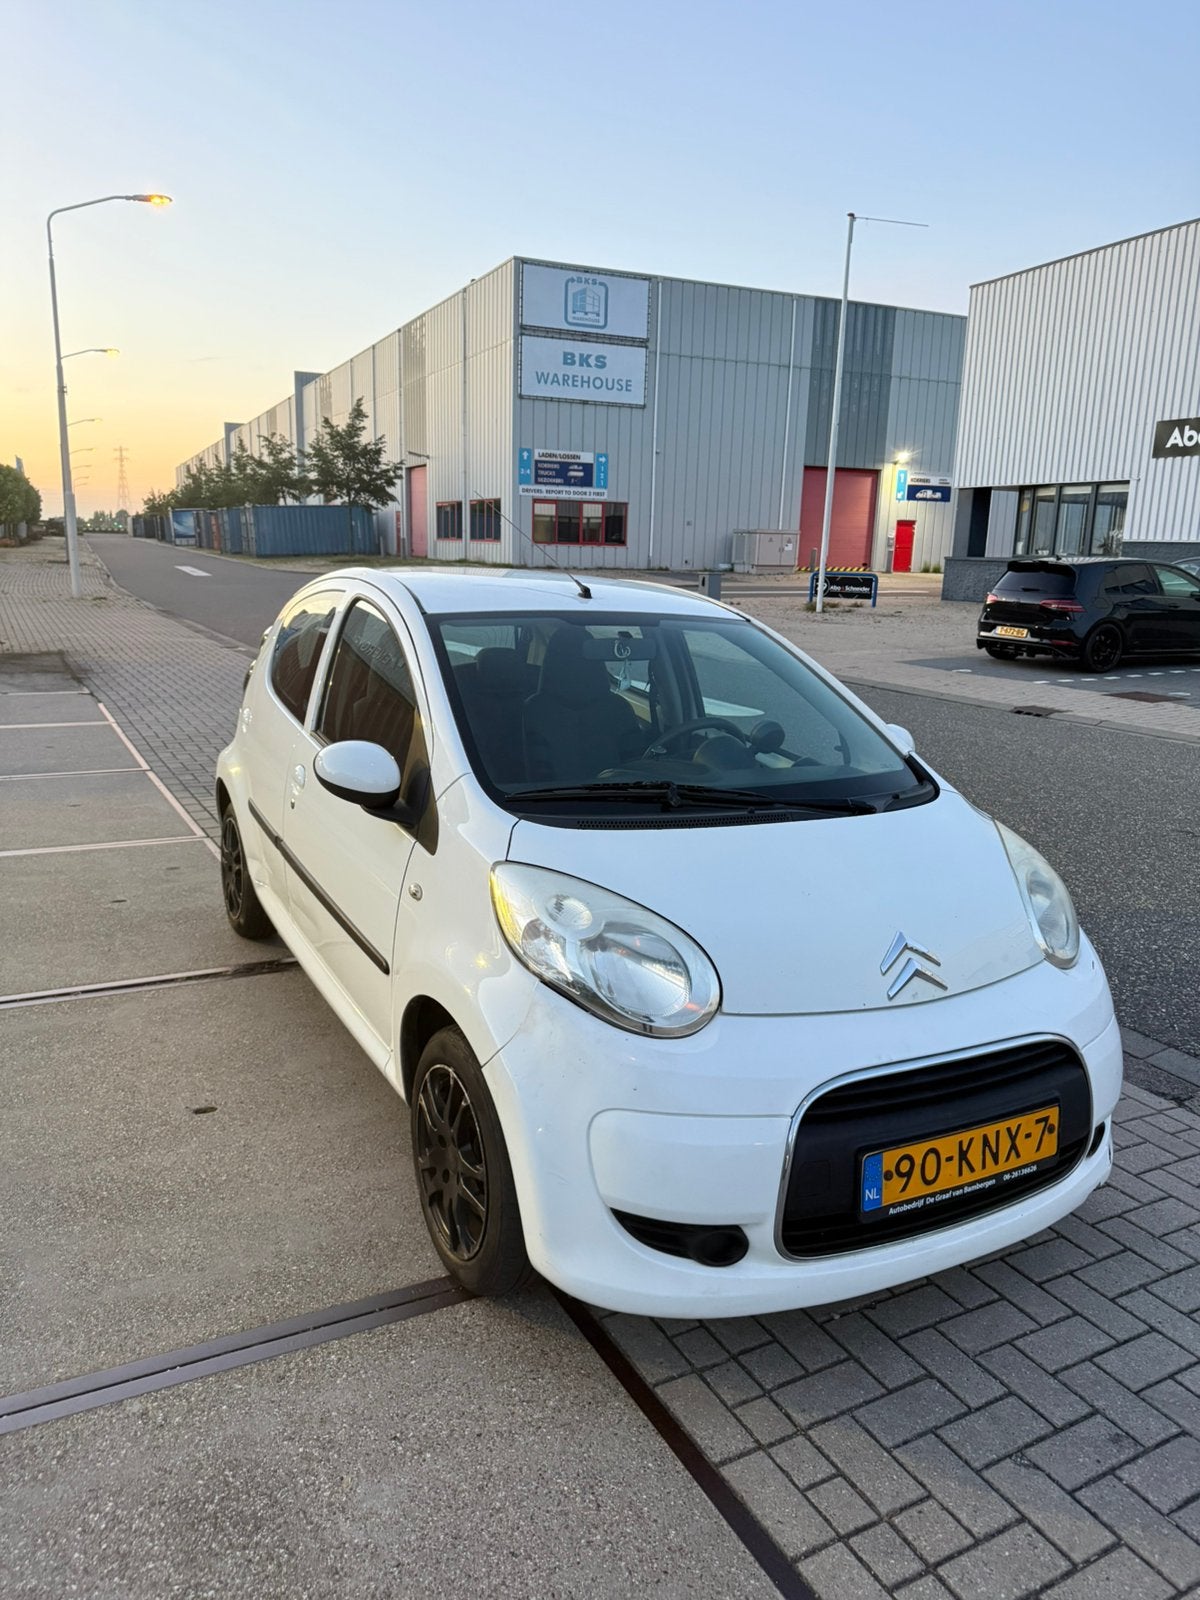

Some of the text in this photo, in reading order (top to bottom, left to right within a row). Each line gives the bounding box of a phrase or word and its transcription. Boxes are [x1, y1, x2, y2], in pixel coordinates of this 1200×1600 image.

[576, 276, 598, 286] BKS
[562, 351, 607, 369] BKS
[535, 371, 632, 392] WAREHOUSE
[1165, 425, 1200, 448] Ab
[894, 1115, 1050, 1193] 90-KNX-7
[865, 1188, 880, 1201] NL
[888, 1198, 925, 1215] Autobedrijf
[925, 1196, 935, 1205] De
[935, 1191, 953, 1201] Graaf
[952, 1188, 963, 1197] van
